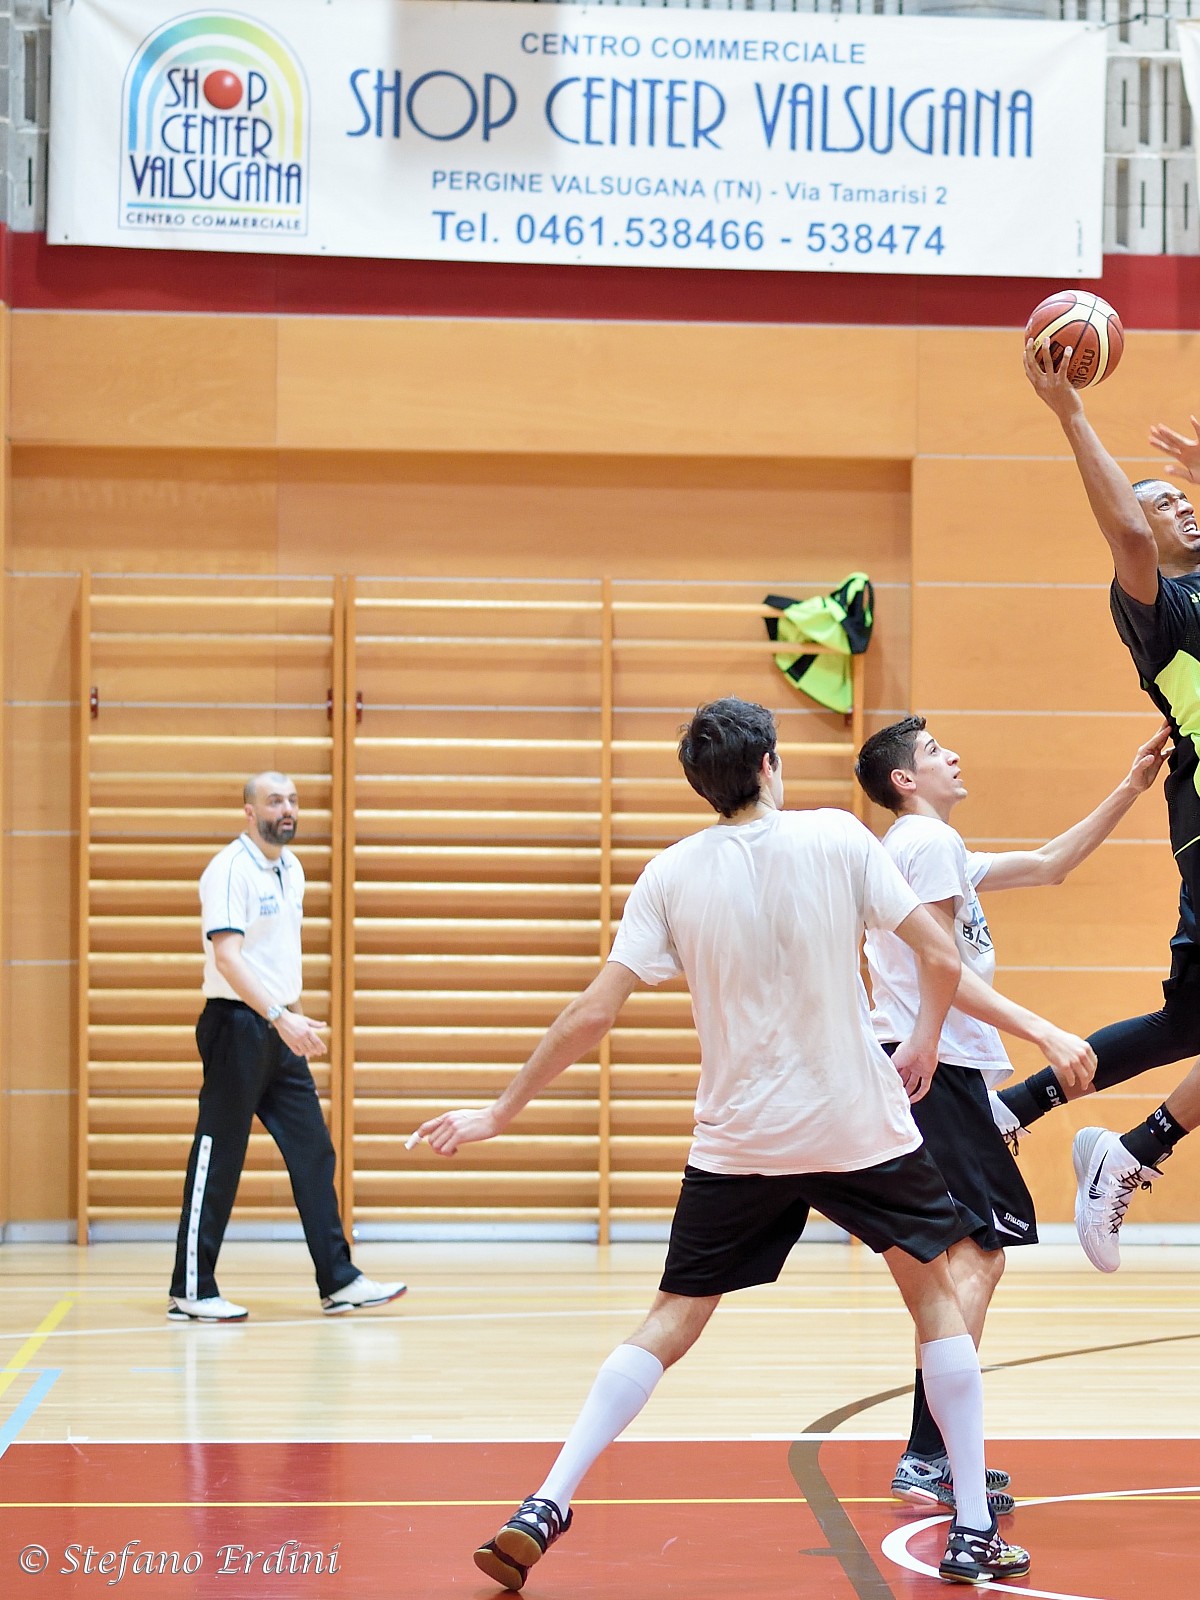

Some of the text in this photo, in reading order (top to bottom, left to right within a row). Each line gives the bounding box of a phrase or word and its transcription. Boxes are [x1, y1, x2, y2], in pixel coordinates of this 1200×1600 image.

[519, 30, 866, 65] CENTRO COMMERCIALE
[167, 67, 268, 110] SHOP
[346, 68, 1034, 159] SHOP CENTER VALSUGANA
[161, 114, 273, 159] CENTER
[129, 154, 302, 204] VALSUGANA
[432, 169, 543, 193] PERGINE
[550, 174, 706, 198] VALSUGANA
[714, 179, 762, 204] (TN)
[785, 181, 820, 201] Via
[829, 182, 927, 205] Tamarisi
[935, 185, 948, 206] 2
[126, 211, 300, 231] CENTRO COMMERCIALE
[431, 209, 499, 244] Tel.
[515, 212, 765, 252] 0461.538466
[806, 221, 946, 257] 538474
[1154, 1108, 1172, 1133] GM
